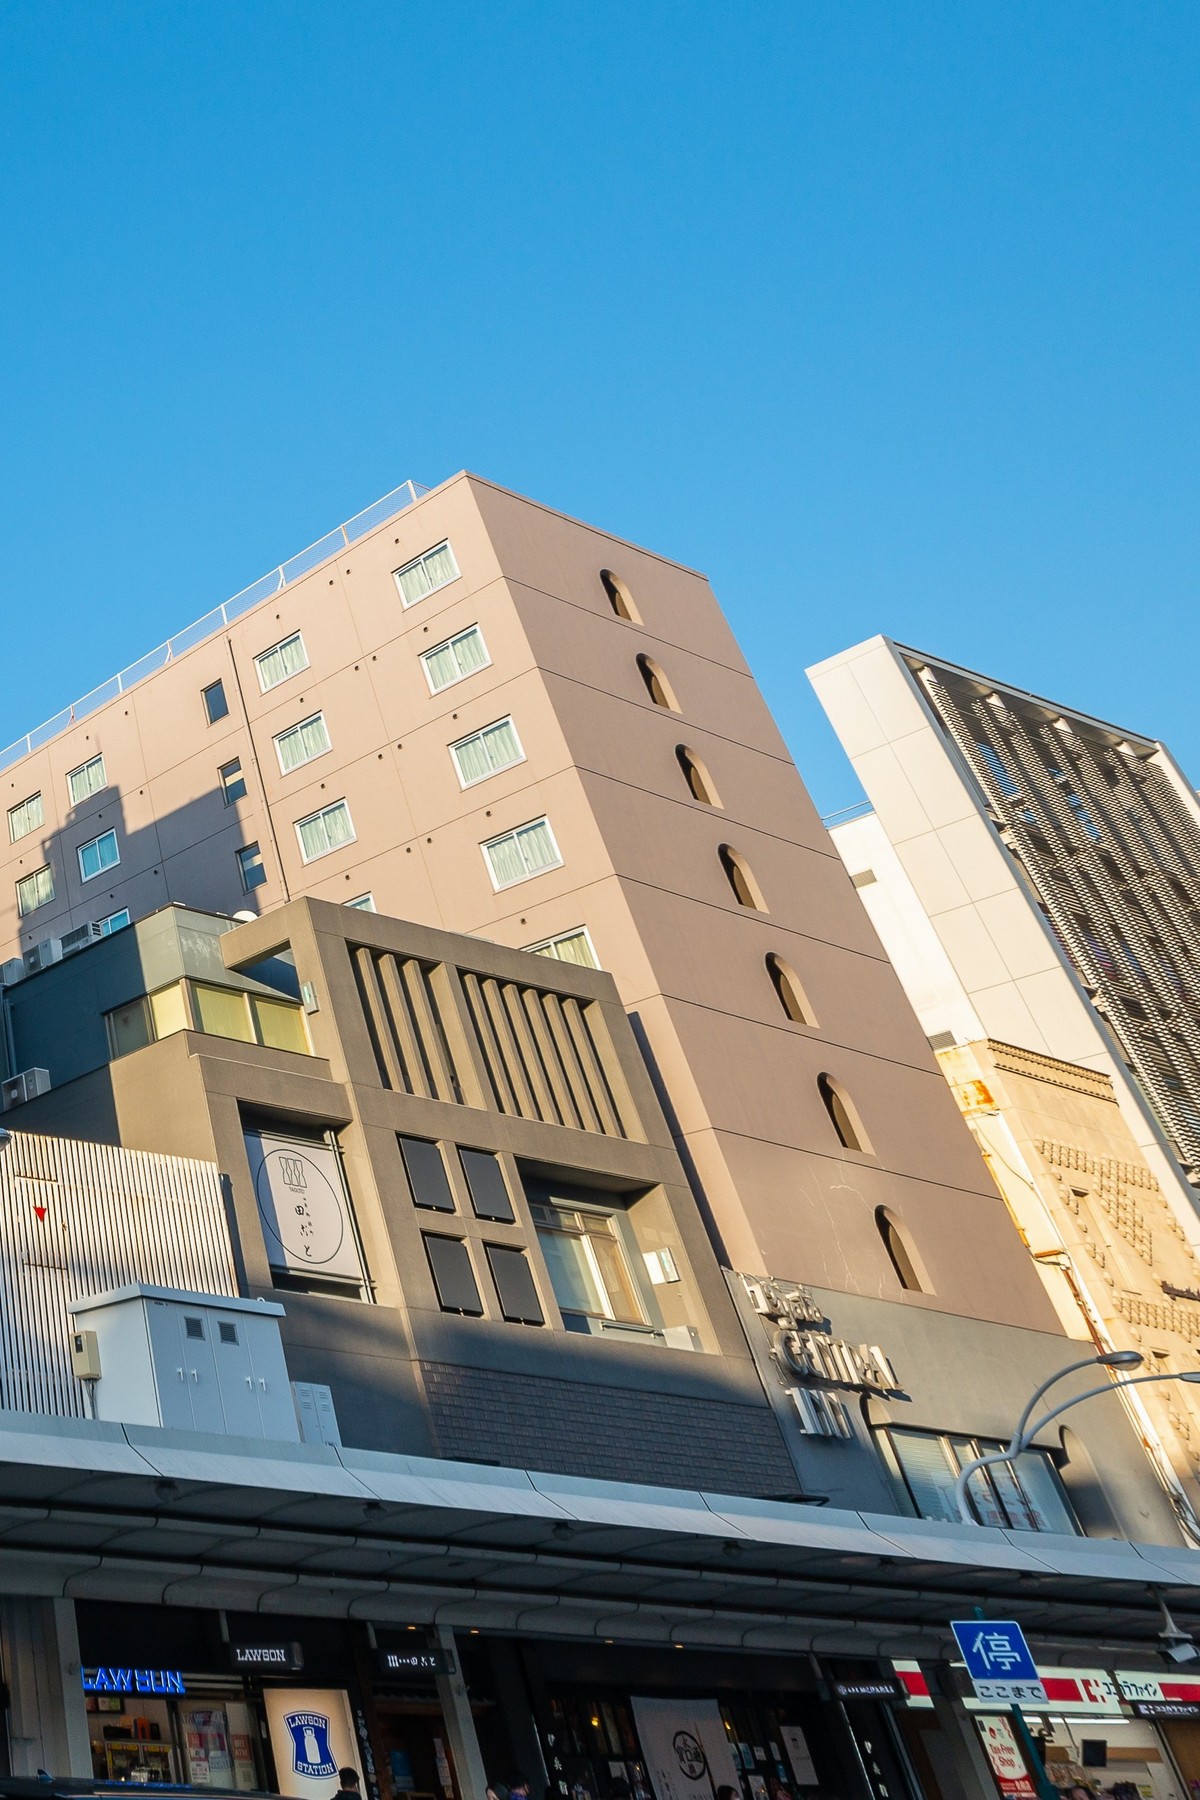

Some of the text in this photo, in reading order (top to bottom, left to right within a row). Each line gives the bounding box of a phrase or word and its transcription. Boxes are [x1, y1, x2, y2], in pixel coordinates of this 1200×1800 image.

[236, 1647, 286, 1663] LAWSON
[972, 1631, 1021, 1672] 停
[979, 1684, 1044, 1700] ここまで
[288, 1715, 326, 1729] LAWSON
[297, 1761, 335, 1776] STATION
